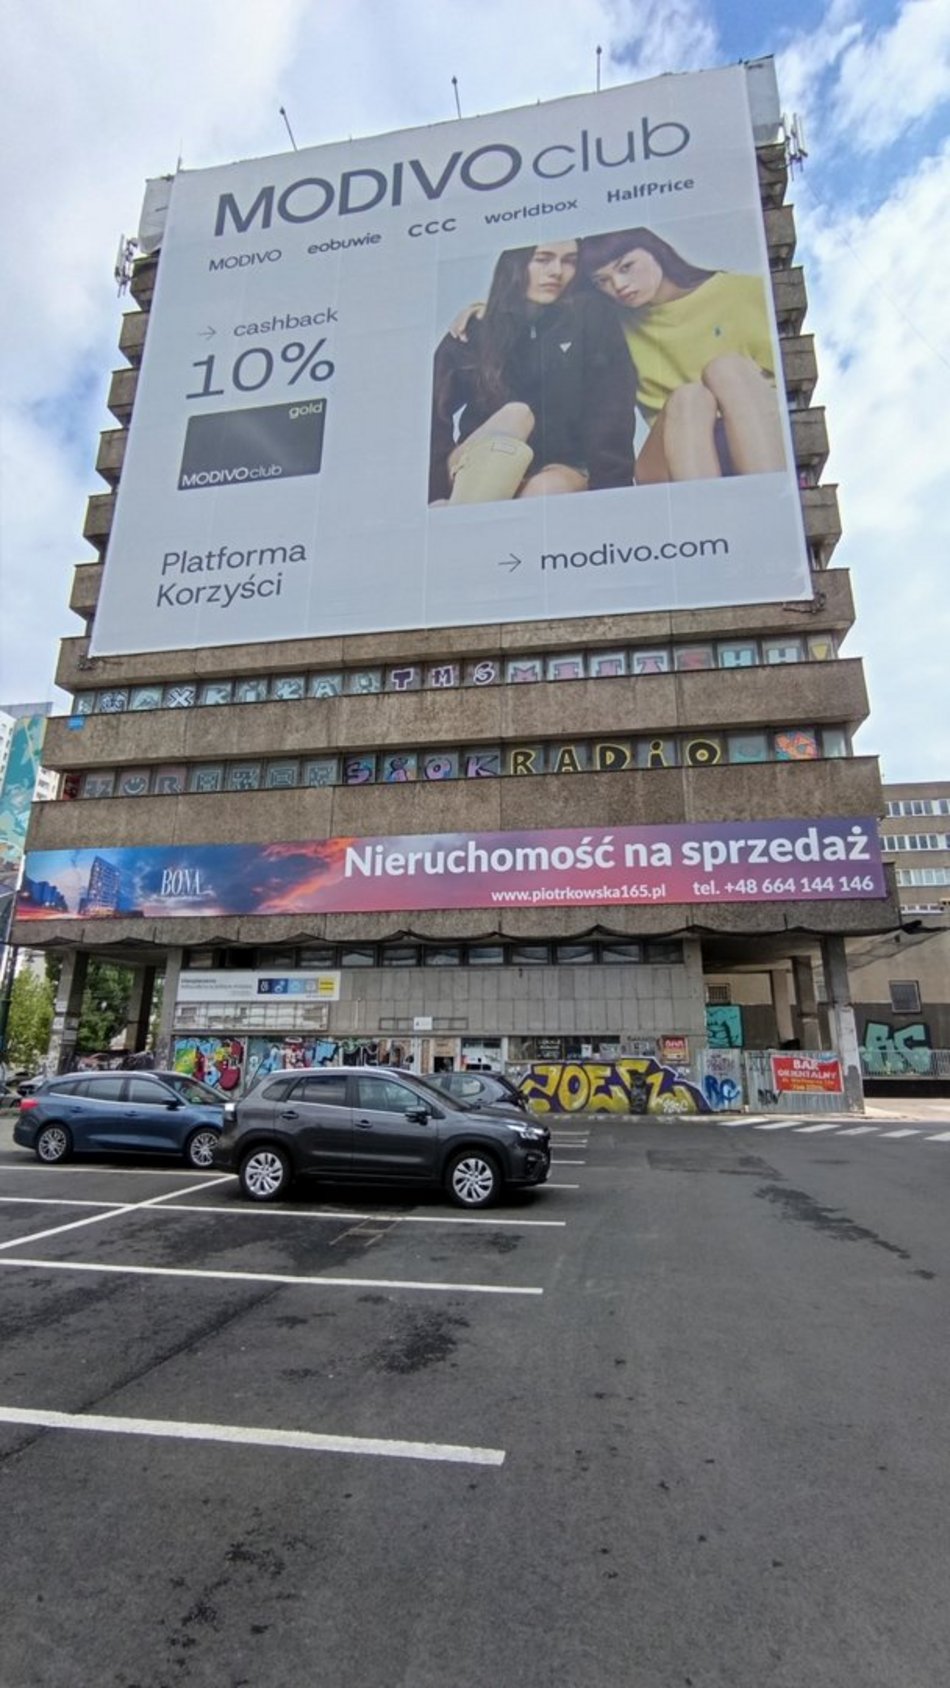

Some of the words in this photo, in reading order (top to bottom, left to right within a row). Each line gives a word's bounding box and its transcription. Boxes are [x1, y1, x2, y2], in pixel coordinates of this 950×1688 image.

[208, 249, 282, 271] MODIVO
[307, 232, 382, 254] eobuwie
[484, 198, 578, 224] worldbox
[607, 177, 695, 203] HalfPrice
[233, 307, 339, 336] cashback
[186, 338, 335, 399] 10%
[289, 401, 323, 419] gold
[161, 544, 307, 576] Platforma
[540, 538, 729, 570] modivo.com
[157, 572, 283, 608] Korzyści
[344, 834, 616, 877] Nieruchomość
[625, 841, 672, 868] na
[681, 825, 871, 872] sprzedaż
[491, 884, 666, 902] www.piotrkowska165.pl
[693, 880, 720, 895] tel.
[724, 878, 758, 894] +48
[761, 877, 796, 893] 664
[801, 876, 834, 892] 144
[839, 875, 874, 891] 146
